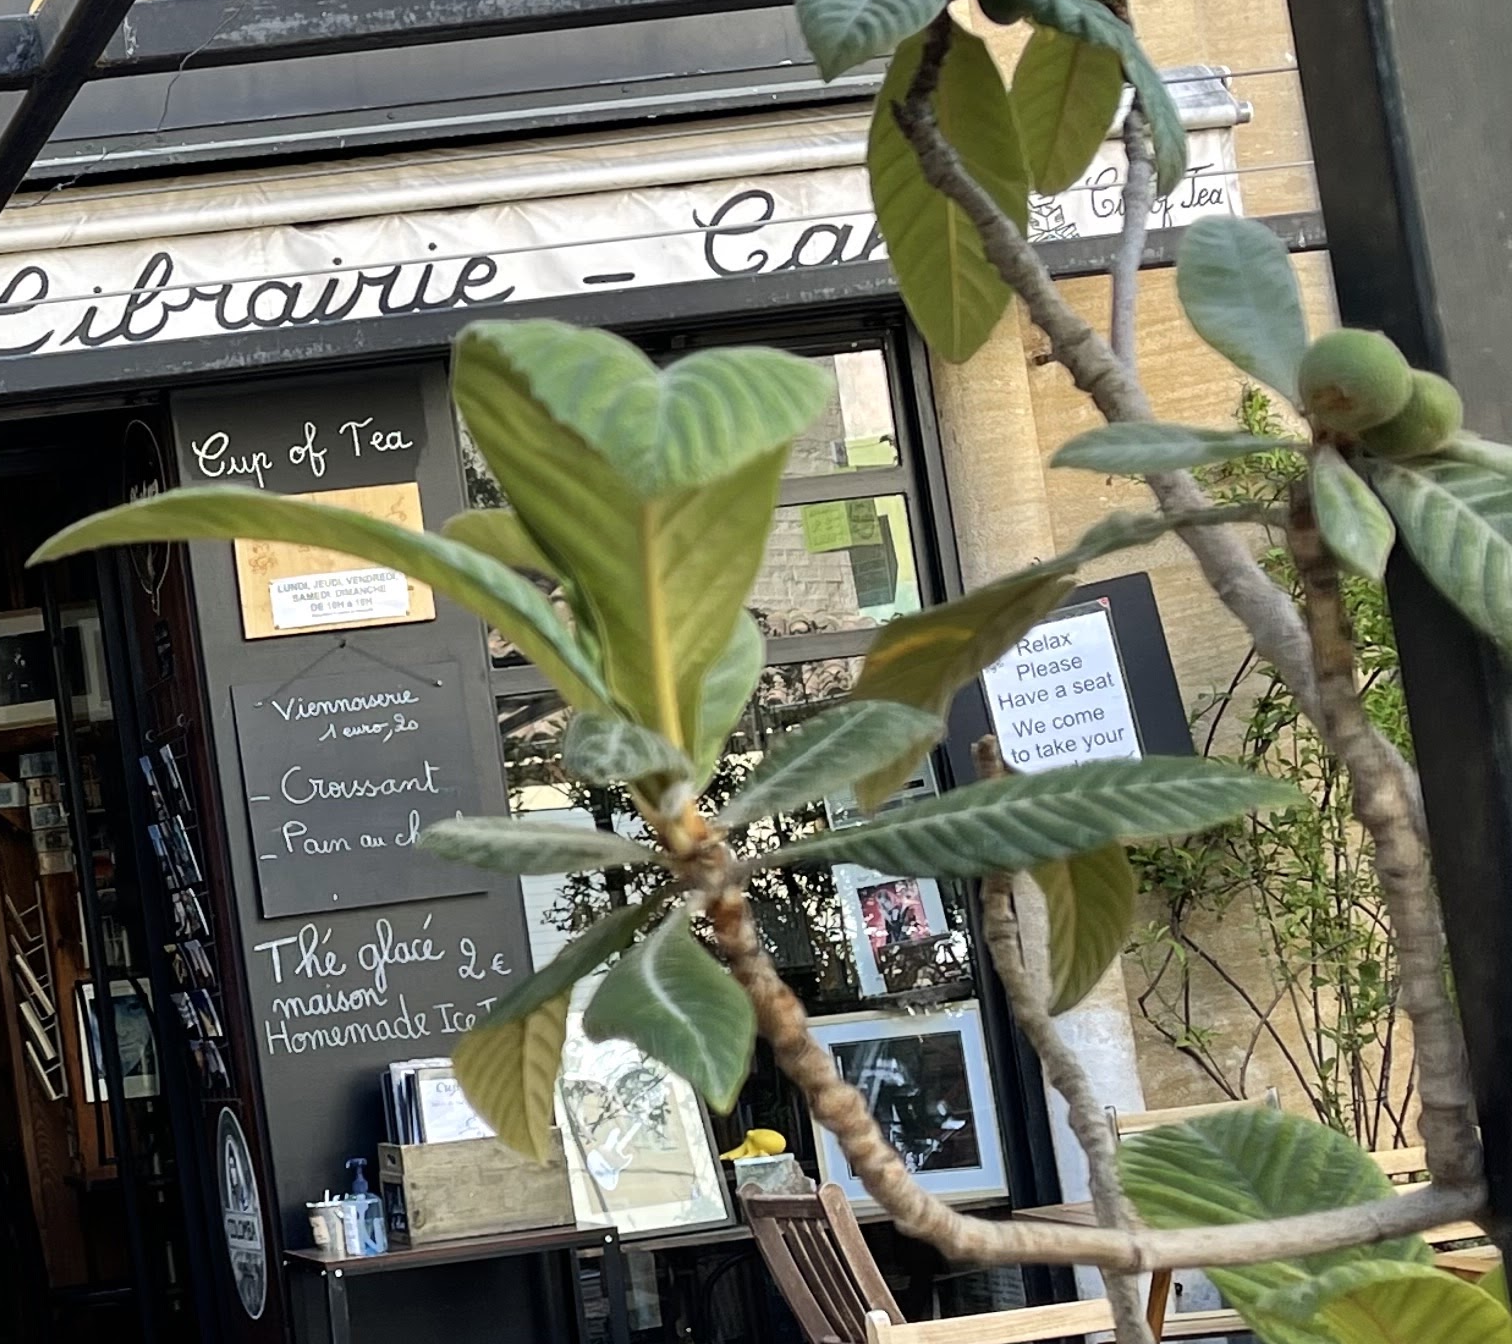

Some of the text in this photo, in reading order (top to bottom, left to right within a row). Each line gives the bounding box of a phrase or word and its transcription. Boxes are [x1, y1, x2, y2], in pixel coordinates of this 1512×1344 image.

[1181, 163, 1224, 208] Tea
[191, 417, 413, 489] Cup of Tea
[1015, 631, 1073, 656] Relax
[1016, 655, 1083, 682] Please
[271, 688, 420, 721] Viennoiserie
[997, 671, 1116, 711] Have a seat
[1012, 707, 1105, 738] We come
[1010, 727, 1126, 765] to take your
[281, 760, 440, 805] Croissant
[281, 820, 387, 857] Pain au
[253, 922, 347, 984] Thé
[357, 913, 445, 994] glacé
[457, 937, 486, 980] 2
[272, 983, 388, 1020] maison
[264, 994, 431, 1055] Homemade
[432, 1003, 477, 1035] Ice
